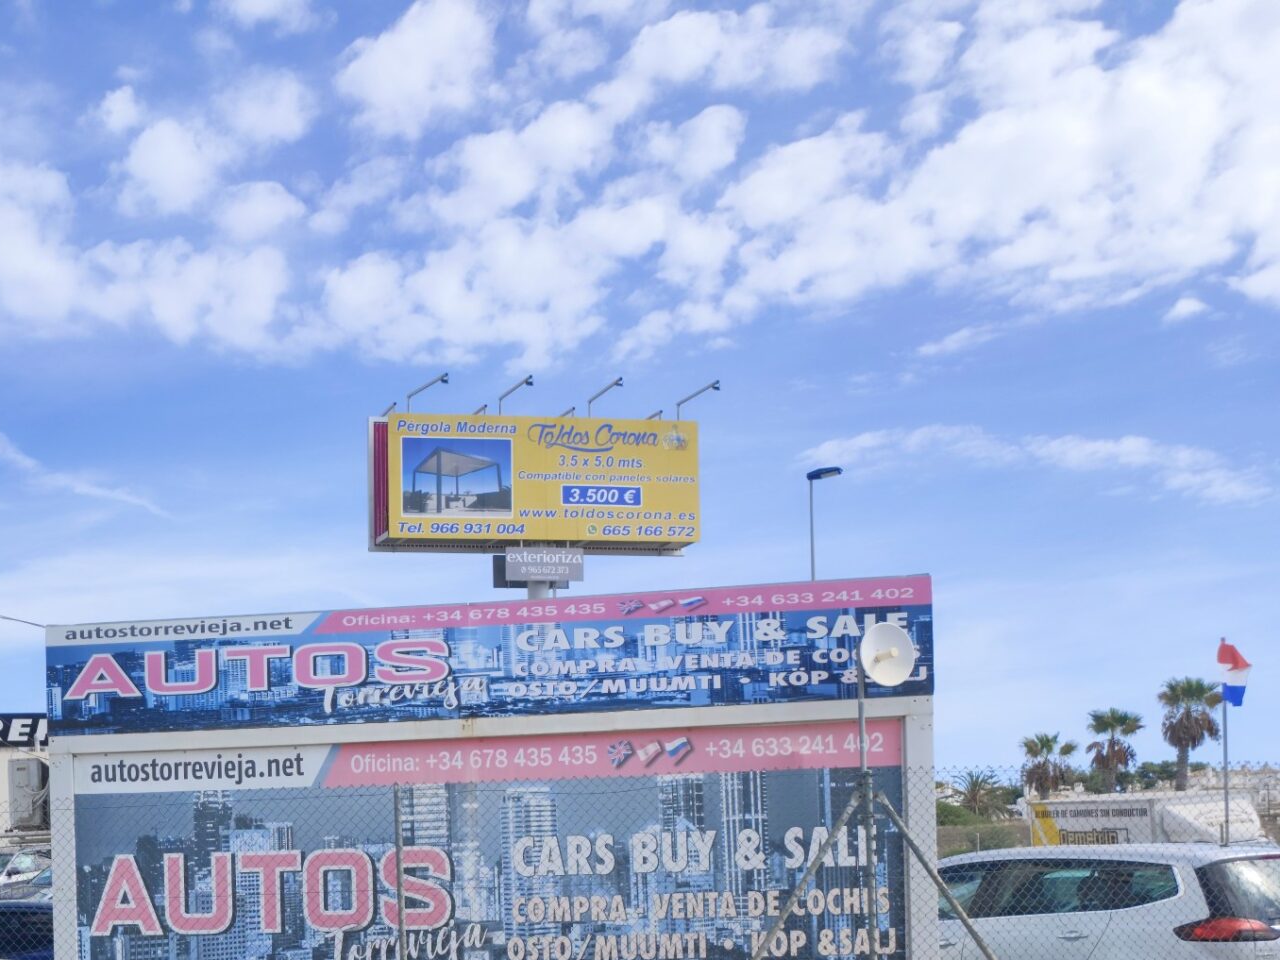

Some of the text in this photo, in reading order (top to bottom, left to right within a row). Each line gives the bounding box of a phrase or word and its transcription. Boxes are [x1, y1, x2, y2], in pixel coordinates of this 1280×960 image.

[456, 421, 517, 434] Moderna
[527, 423, 658, 450] Toldos Corona
[518, 471, 582, 482] Compatible
[609, 474, 652, 484] paneles
[656, 475, 696, 483] solares
[569, 488, 636, 504] 3.500 €
[519, 508, 696, 521] www.toldoscorona.es
[398, 522, 526, 535] Tel. 966 931 004
[602, 525, 696, 537] 665 166 572
[506, 550, 583, 564] exterioriza
[722, 587, 915, 607] +34 633 241 402
[65, 615, 293, 641] autostorrevieja.net
[342, 602, 606, 628] Oficina: +34 678 435 435
[517, 622, 625, 652] CARS
[644, 619, 737, 648] BUY
[755, 618, 788, 642] &
[63, 639, 452, 702] AUTOS
[516, 656, 638, 677] COMPRA
[662, 651, 757, 670] VENTA
[765, 649, 801, 666] DE
[768, 667, 829, 687] KÖP
[318, 673, 490, 714] Torrevieja
[705, 732, 884, 759] +34 633 241 402
[90, 752, 304, 785] autostorrevieja.net
[350, 745, 598, 775] Oficina: +34 678 435 435
[513, 833, 616, 877] CARS
[632, 830, 717, 874] BUY
[735, 828, 767, 871] &
[91, 846, 455, 936] AUTOS
[512, 895, 627, 924] COMPRA
[653, 890, 738, 920] VENTA
[748, 890, 781, 917] DE
